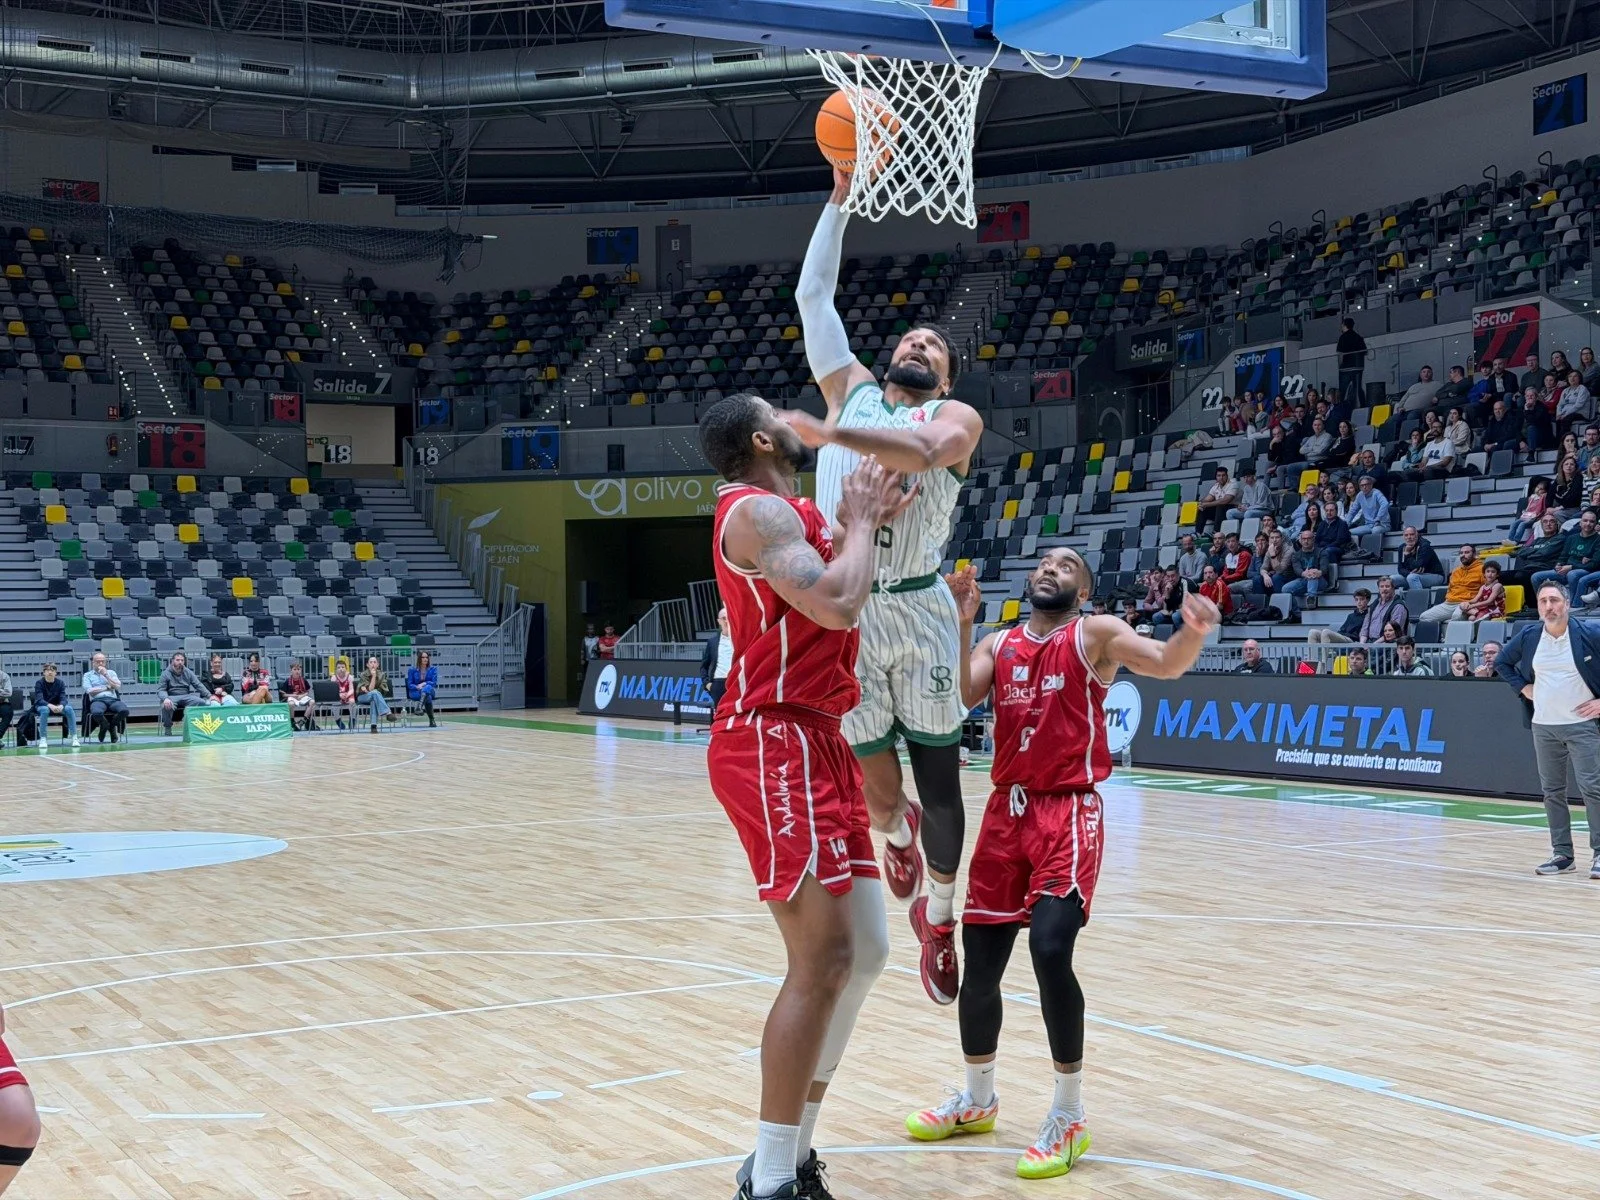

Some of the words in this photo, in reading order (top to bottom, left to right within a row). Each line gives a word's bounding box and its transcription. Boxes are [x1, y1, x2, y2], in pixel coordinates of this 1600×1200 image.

[1533, 82, 1568, 100] Sector
[42, 179, 80, 190] Sector
[977, 204, 1011, 214] Sector
[586, 228, 620, 238] Sector
[1474, 311, 1515, 329] Sector
[1177, 332, 1195, 341] Sector
[1130, 339, 1168, 360] Salida
[1234, 352, 1267, 368] Sector
[313, 378, 367, 395] Salida
[374, 372, 392, 394] 7
[1034, 371, 1059, 379] Sector
[1281, 375, 1304, 399] 22
[269, 392, 295, 401] Sector
[1203, 387, 1223, 411] 22
[137, 422, 180, 434] Sector
[500, 427, 538, 438] Sector
[7, 436, 34, 455] 17
[148, 424, 205, 468] 18
[327, 445, 352, 464] 18
[416, 447, 439, 466] 18
[633, 477, 702, 501] olivo
[252, 713, 289, 722] RURAL
[1153, 698, 1445, 754] MAXIMETAL
[1275, 748, 1313, 764] Precisión
[1313, 752, 1330, 767] que
[1331, 754, 1342, 767] se
[1342, 753, 1385, 770] convierte
[1385, 757, 1397, 770] en
[1397, 757, 1442, 774] confianza
[828, 836, 848, 859] 14
